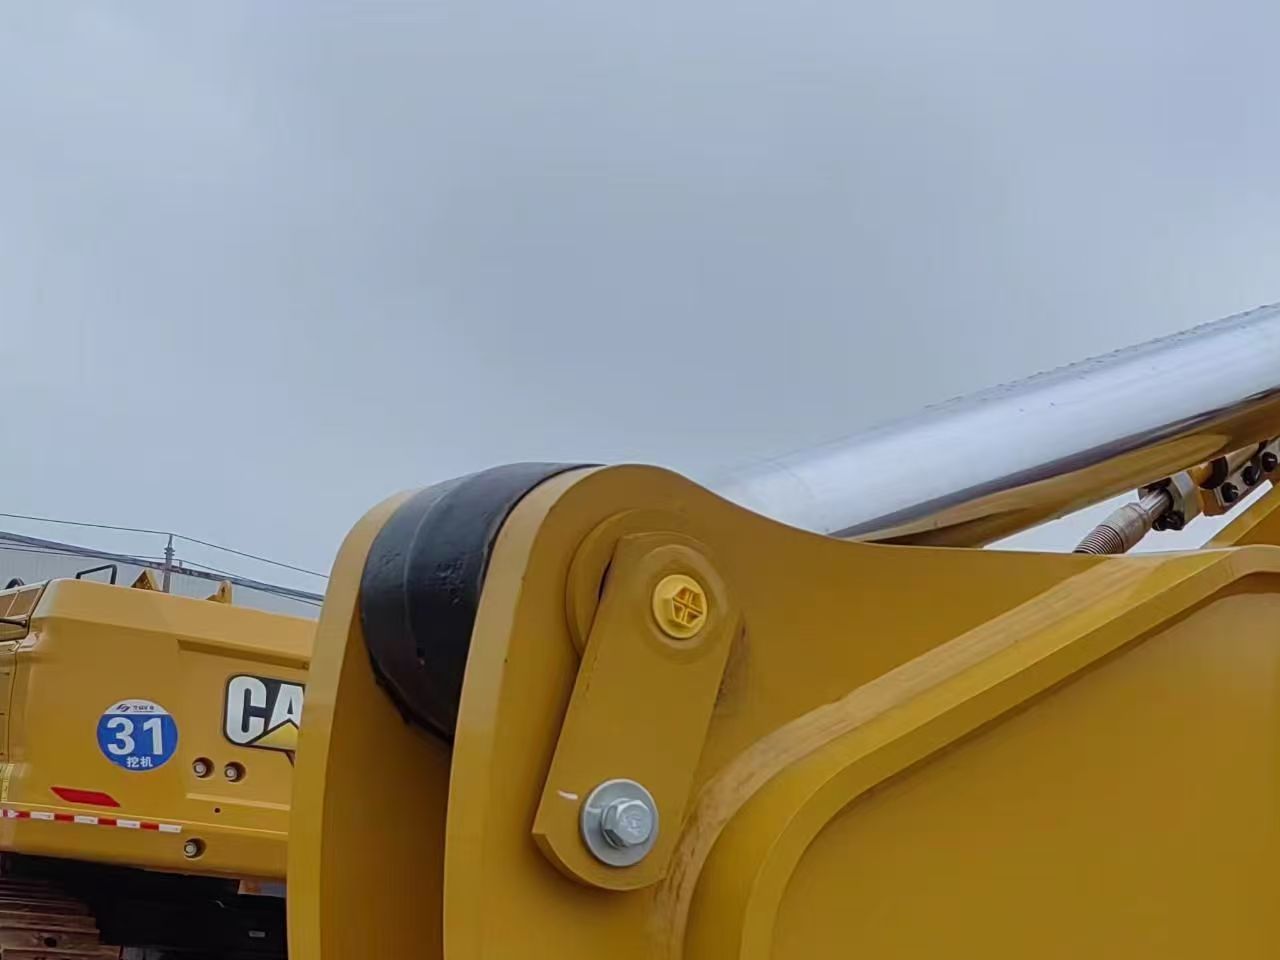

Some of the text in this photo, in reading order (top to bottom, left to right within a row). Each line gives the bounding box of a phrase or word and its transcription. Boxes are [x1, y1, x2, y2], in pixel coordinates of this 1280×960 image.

[226, 675, 304, 744] CA
[107, 716, 163, 756] 31
[126, 756, 153, 768] 挖机
